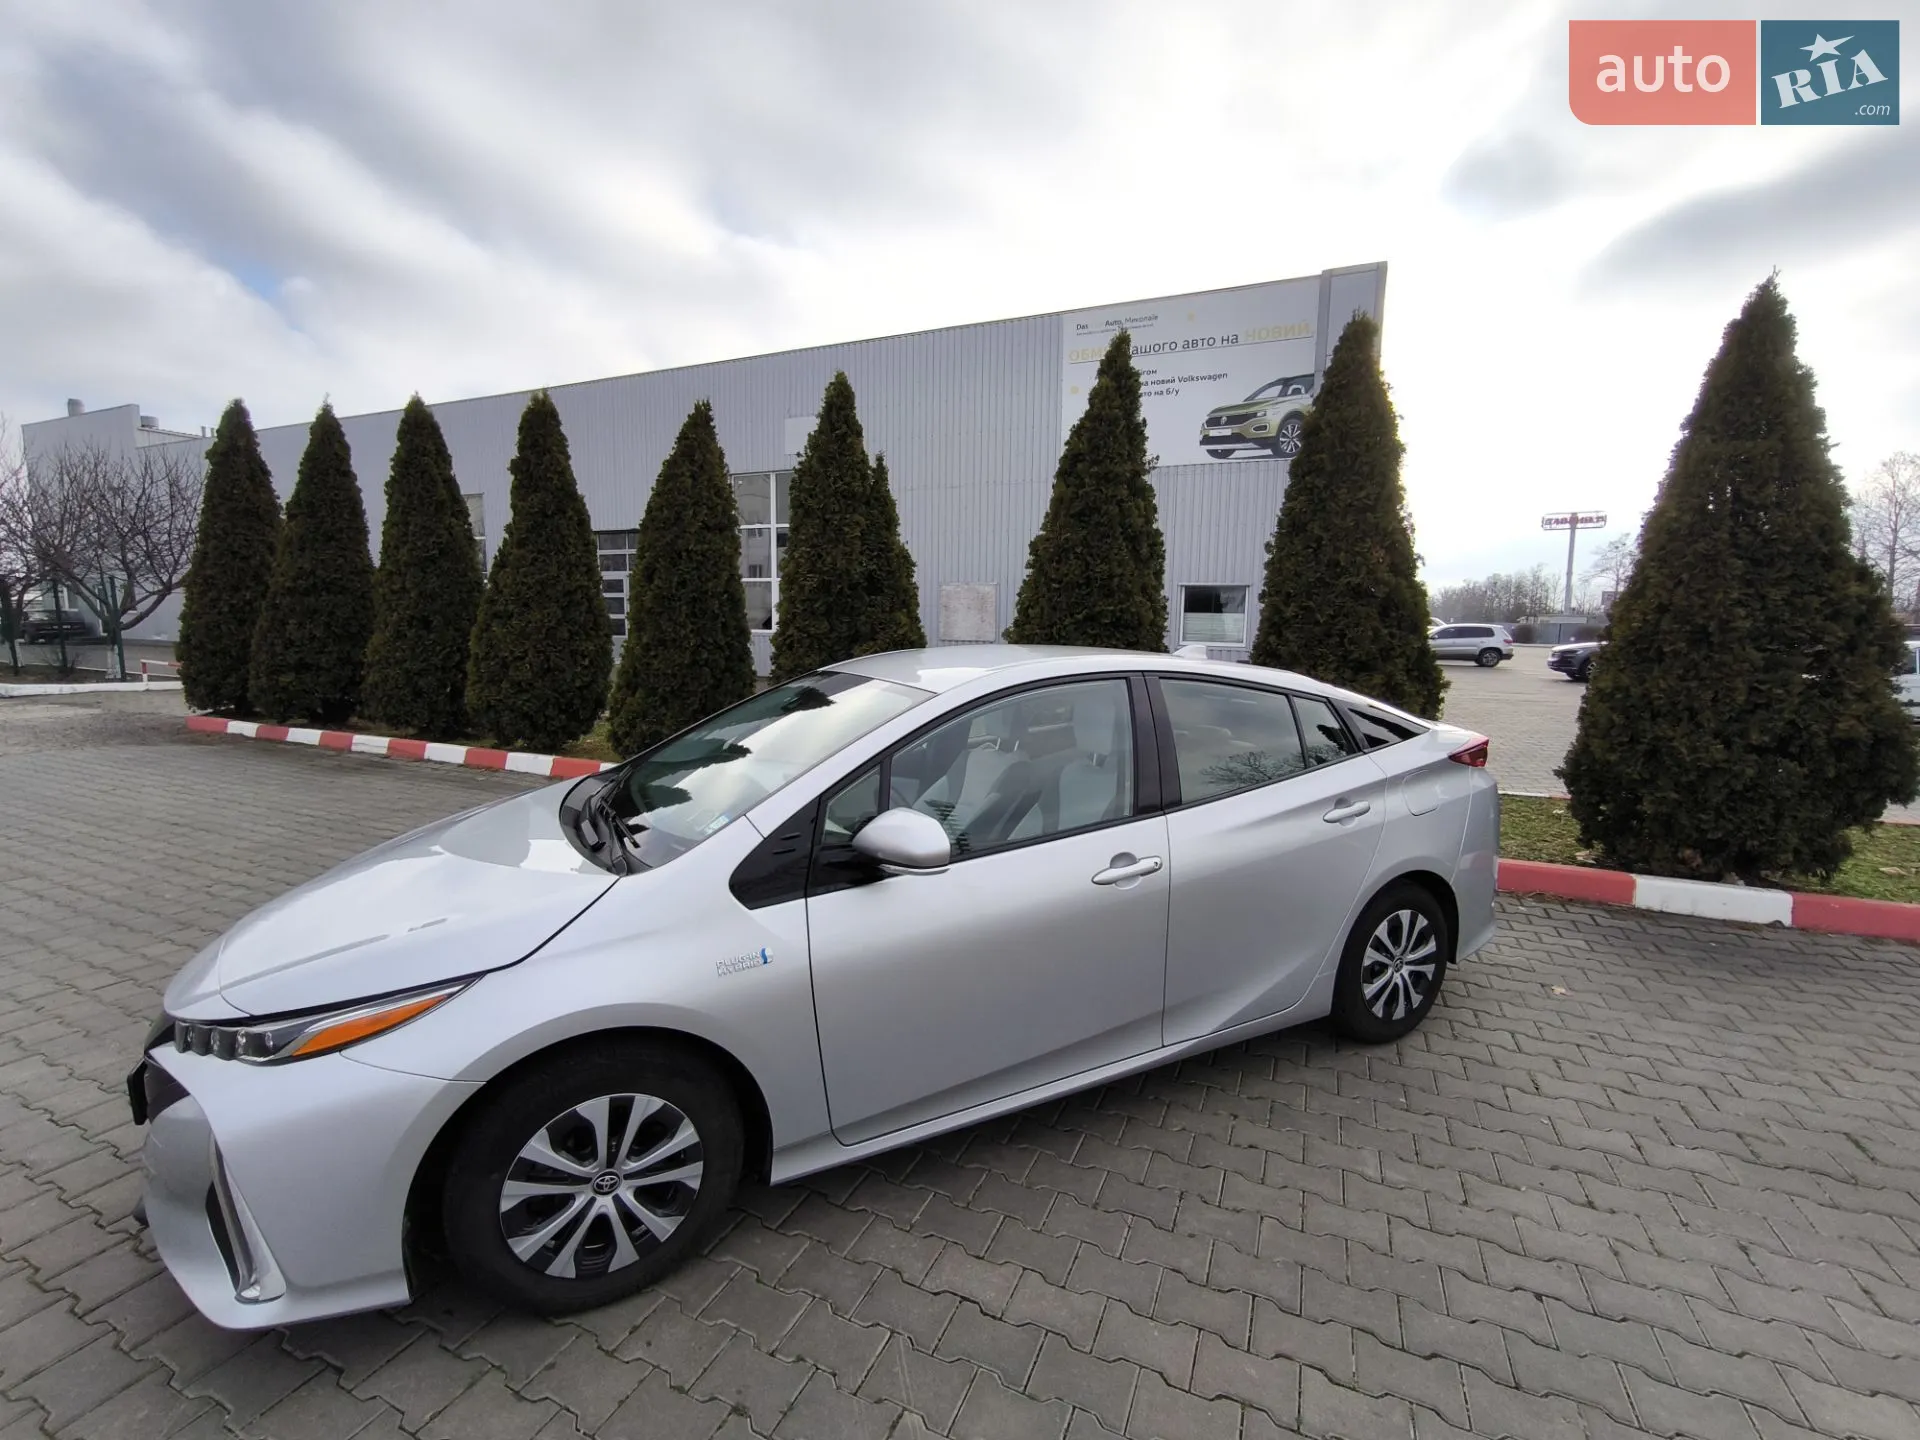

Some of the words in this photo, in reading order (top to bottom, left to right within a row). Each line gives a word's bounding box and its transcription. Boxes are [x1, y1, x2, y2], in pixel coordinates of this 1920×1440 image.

[1131, 341, 1178, 356] ашого
[1182, 337, 1216, 350] авто
[1221, 334, 1239, 346] на
[1150, 376, 1176, 386] новий
[1177, 372, 1228, 383] Volkswagen
